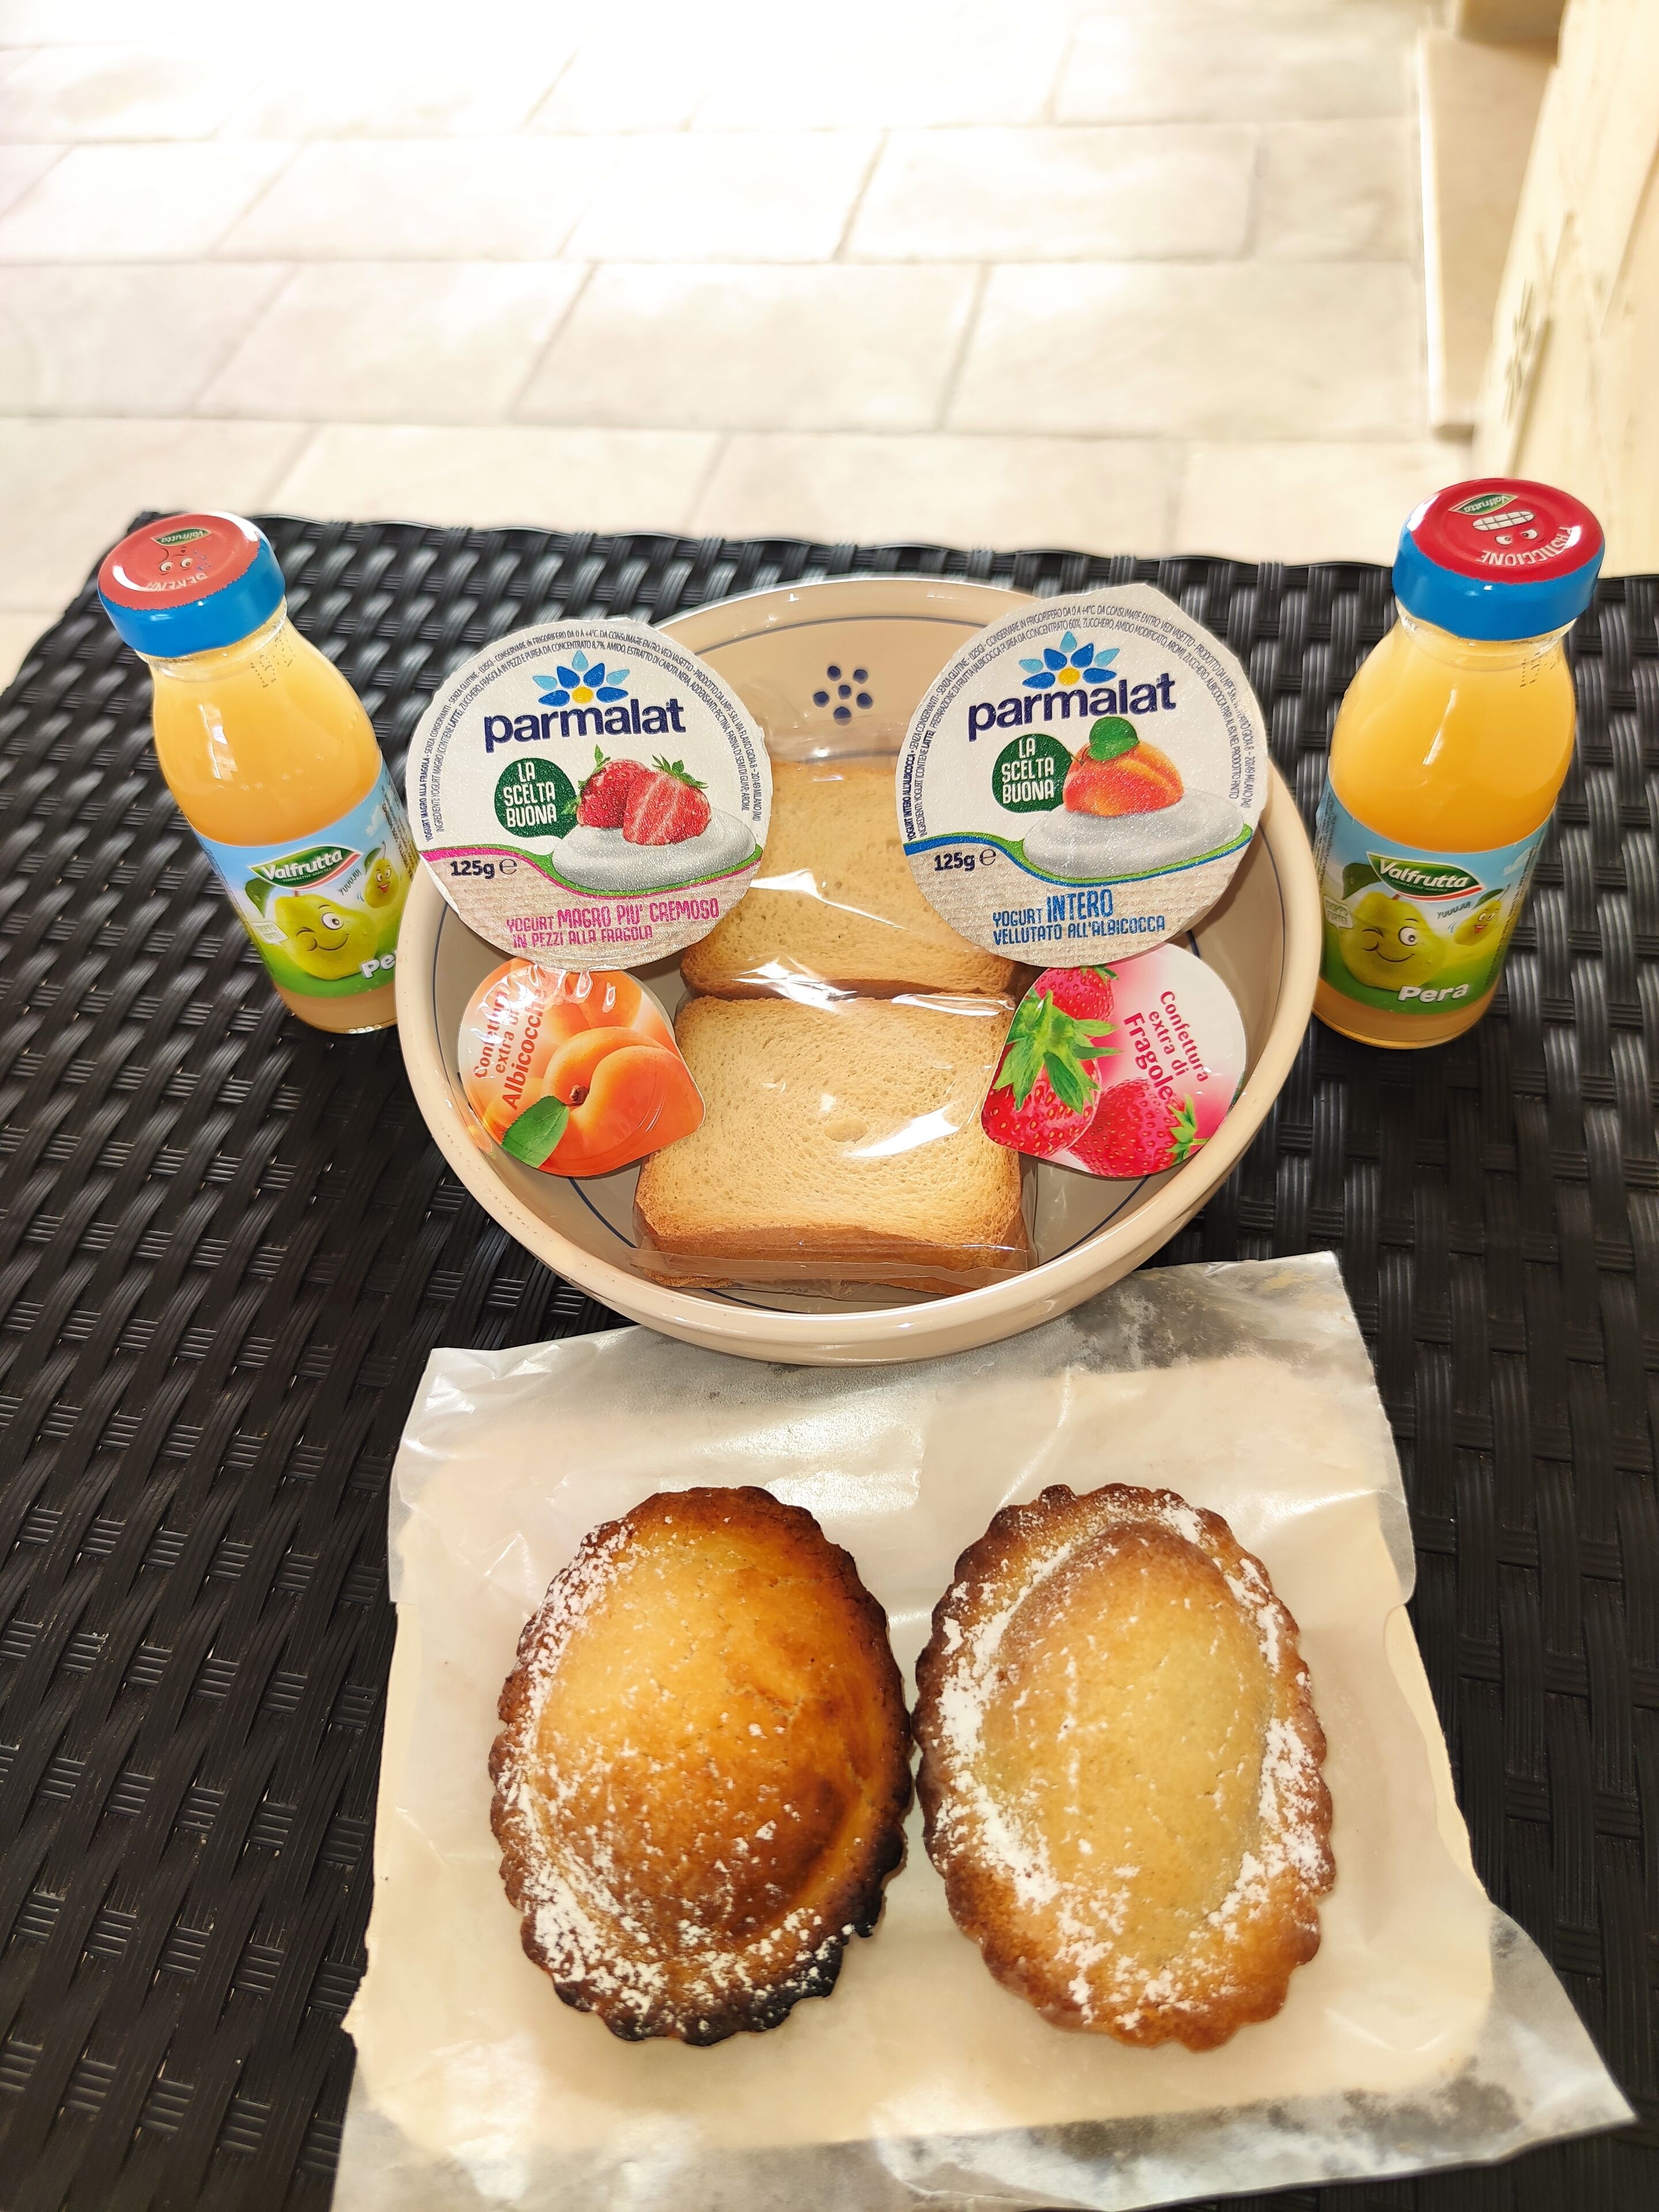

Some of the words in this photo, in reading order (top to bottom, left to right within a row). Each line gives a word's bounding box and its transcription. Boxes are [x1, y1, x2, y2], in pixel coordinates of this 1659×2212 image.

[1463, 494, 1512, 513] Valfrutta
[161, 529, 204, 543] Valfrutta
[1096, 605, 1106, 615] DA
[566, 630, 575, 638] DA
[599, 630, 608, 638] DA
[608, 630, 643, 646] CONSUMARE
[1170, 626, 1196, 648] VASETTO
[524, 647, 543, 661] PUREA
[541, 645, 551, 654] DA
[551, 640, 590, 653] CONCENTRATO
[626, 646, 654, 662] ESTRATTO
[500, 662, 509, 672] IN
[657, 658, 680, 676] CAROTA
[671, 653, 695, 672] VASETTO
[1192, 643, 1222, 673] PRODOTTO
[459, 671, 479, 691] GLUTINE
[479, 666, 504, 688] FRAGOLA
[692, 669, 719, 695] PRODOTTO
[1214, 667, 1227, 679] DA
[448, 687, 463, 704] SENZA
[714, 691, 726, 702] DA
[935, 676, 953, 695] SENZA
[914, 695, 940, 733] CONSERVANTI
[968, 673, 1176, 741] parmalat
[429, 703, 452, 738] CONSERVANTI
[483, 698, 687, 753] parmalat
[733, 721, 745, 732] VIA
[738, 729, 752, 749] FLAVIO
[908, 732, 922, 750] SENZA
[914, 779, 923, 801] YOGURT
[928, 689, 957, 729] PREPARAZIONE
[955, 667, 976, 688] FRUTTA
[1203, 676, 1228, 709] ALBICOCCA
[423, 737, 435, 755] SENZA
[1019, 737, 1036, 759] LA
[419, 756, 430, 782] FRAGOLA
[431, 753, 444, 775] MAGRO
[518, 762, 535, 783] LA
[1002, 757, 1055, 782] SCELTA
[419, 782, 427, 797] ALLA
[430, 775, 441, 797] YOGURT
[751, 771, 762, 788] 20149
[503, 783, 556, 806] SCELTA
[752, 789, 762, 810] MILANO
[1002, 780, 1054, 804] BUONA
[419, 798, 429, 818] MAGRO
[506, 804, 557, 828] BUONA
[901, 796, 912, 817] INTERO
[421, 819, 434, 842] YOGURT
[903, 816, 918, 842] YOGURT
[262, 850, 344, 881] Valfrutta
[450, 860, 494, 878] 125g
[934, 850, 976, 872] 125g
[1379, 858, 1469, 888] Valfrutta
[506, 915, 554, 934] YOGURT
[558, 908, 612, 930] MAGRO
[617, 906, 643, 923] PIU'
[650, 898, 719, 922] CREMOSO
[993, 908, 1043, 928] YOGURT
[1047, 889, 1113, 922] INTERO
[513, 934, 527, 949] IN
[532, 930, 566, 948] PEZZI
[569, 928, 597, 945] ALLA
[601, 925, 653, 944] FRAGOLA
[994, 926, 1062, 945] VELLUTATO
[1068, 915, 1165, 937] ALL'ALBICOCCA
[361, 950, 396, 978] Pe
[1397, 983, 1469, 1003] Pera
[1148, 1011, 1175, 1055] extra
[1170, 1056, 1190, 1077] di
[1160, 991, 1209, 1082] Confettura
[496, 1032, 515, 1074] extra
[502, 987, 549, 1111] Albicocche
[1123, 1012, 1173, 1101] Fragole
